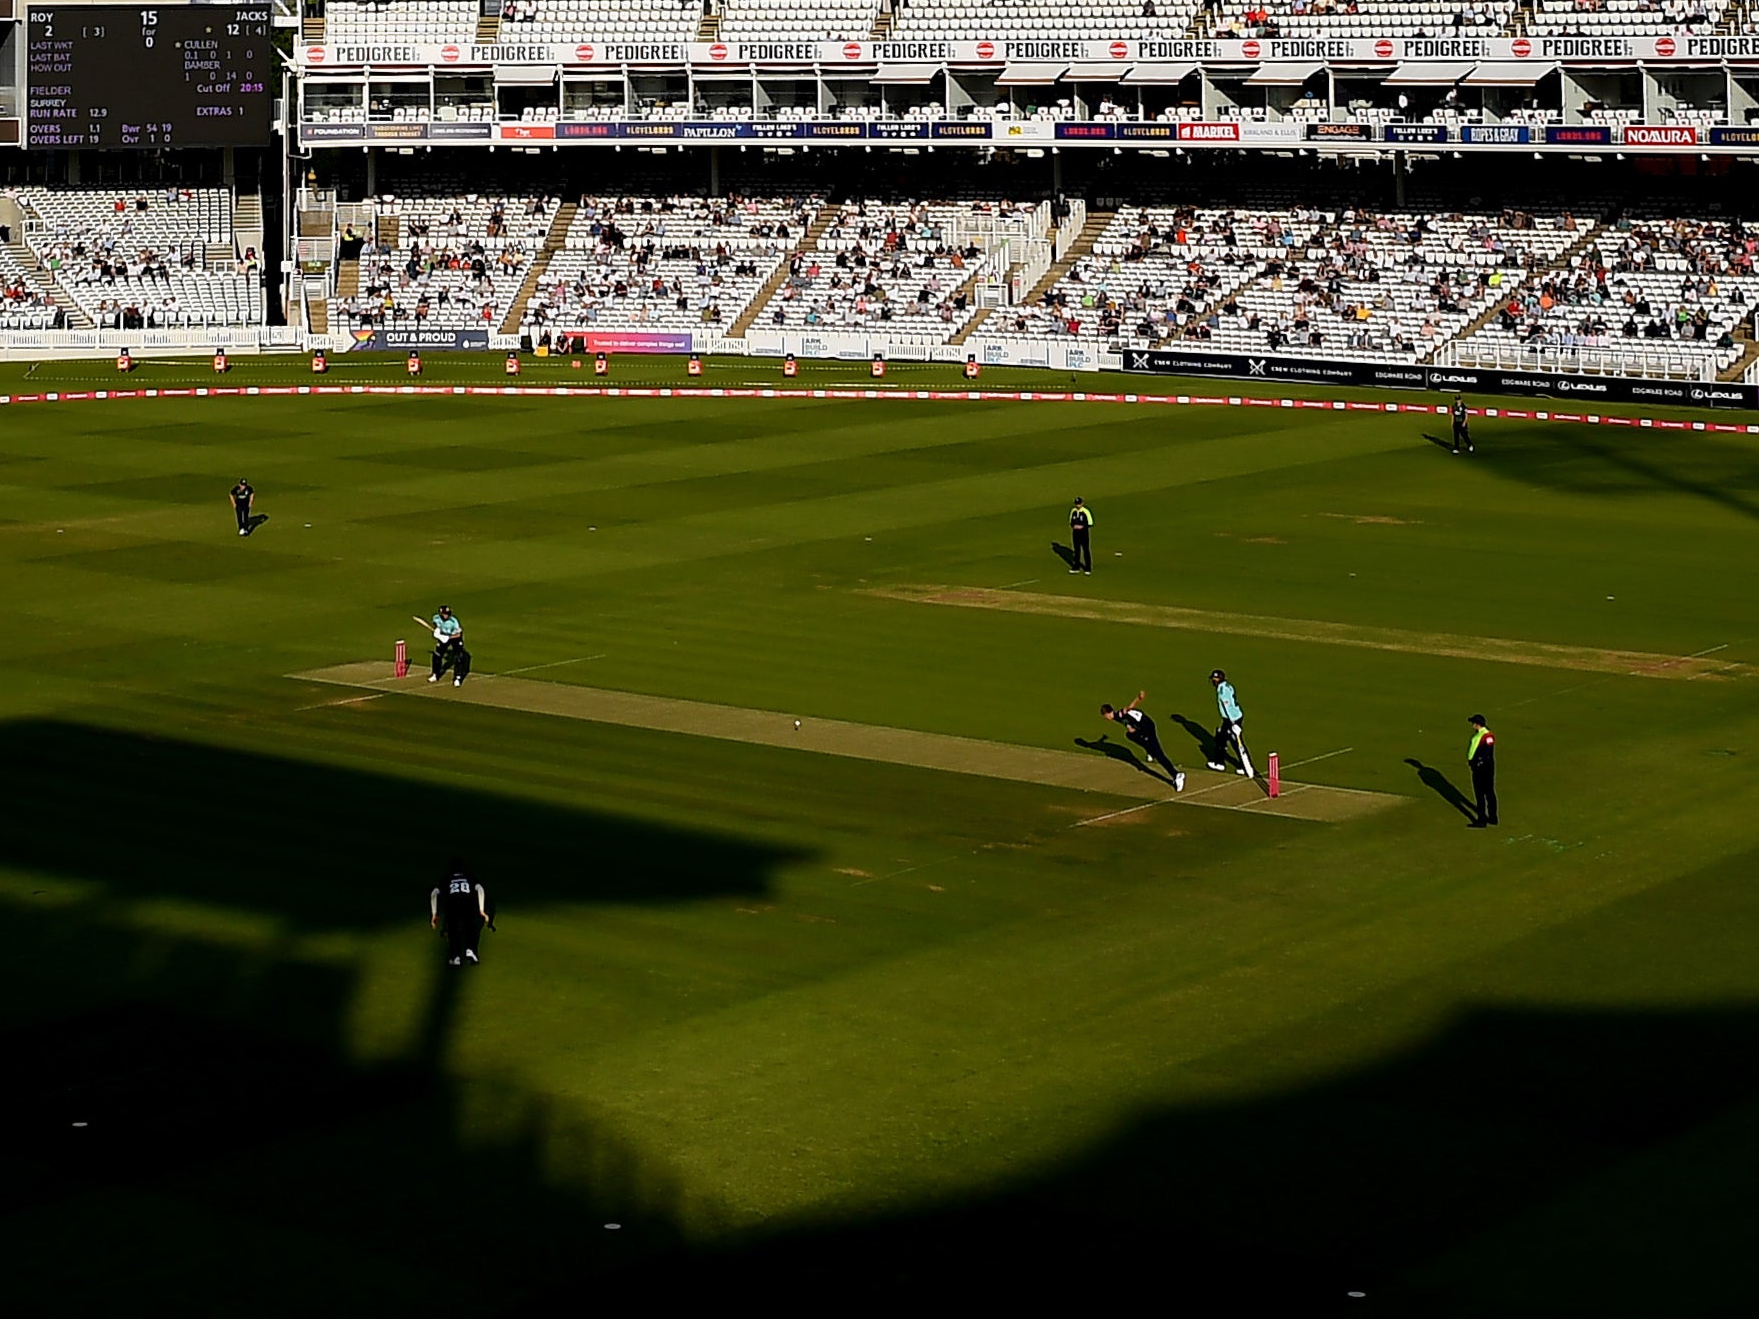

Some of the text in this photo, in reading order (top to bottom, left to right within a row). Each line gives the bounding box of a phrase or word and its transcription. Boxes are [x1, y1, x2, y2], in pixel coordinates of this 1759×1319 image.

[31, 13, 53, 22] ROY
[141, 11, 157, 25] 15
[236, 12, 268, 21] JACKS
[45, 27, 53, 37] 2
[142, 27, 156, 36] for
[226, 25, 240, 35] 12
[31, 41, 73, 50] LAST WKT
[145, 37, 153, 48] 0
[184, 40, 218, 49] CULLEN
[1543, 40, 1622, 55] PEDIGREE
[471, 46, 545, 60] PEDIGREE
[606, 46, 679, 59] PEDIGREE
[739, 45, 813, 59] PEDIGREE
[873, 44, 946, 58] PEDIGREE
[1005, 43, 1079, 57] PEDIGREE
[1139, 43, 1212, 57] PEDIGREE
[1272, 42, 1345, 56] PEDIGREE
[1404, 41, 1480, 56] PEDIGREE
[31, 53, 71, 62] LAST BAT
[184, 50, 198, 59] 0.1
[210, 50, 216, 59] 0
[246, 50, 252, 59] 0
[337, 47, 411, 61] PEDIGREE
[31, 63, 72, 72] HOW OUT
[184, 61, 220, 70] BAMBER
[210, 72, 216, 80] 0
[226, 72, 237, 80] 14
[246, 72, 252, 80] 0
[31, 86, 71, 95] FIELDER
[196, 83, 263, 93] Cut Off 20:15
[31, 99, 66, 107] SURREY
[31, 108, 107, 117] RUN RATE 12.9
[196, 107, 243, 116] EXTRAS 1
[30, 124, 61, 133] OVERS
[90, 124, 100, 133] 1.1
[121, 124, 141, 133] Bwr
[162, 123, 172, 132] 19
[683, 127, 736, 137] PAPILLON
[1192, 126, 1236, 137] MARKEL
[1317, 126, 1359, 134] ENGAGE
[30, 134, 170, 144] OVERS LEFT 19 Ovr 1 0
[1628, 129, 1692, 142] NOMURA
[386, 333, 408, 342] OUT
[419, 333, 456, 342] PROUD
[1442, 376, 1477, 384] LEXUS
[1570, 384, 1607, 392] LEXUS
[1704, 392, 1744, 400] LEXUS
